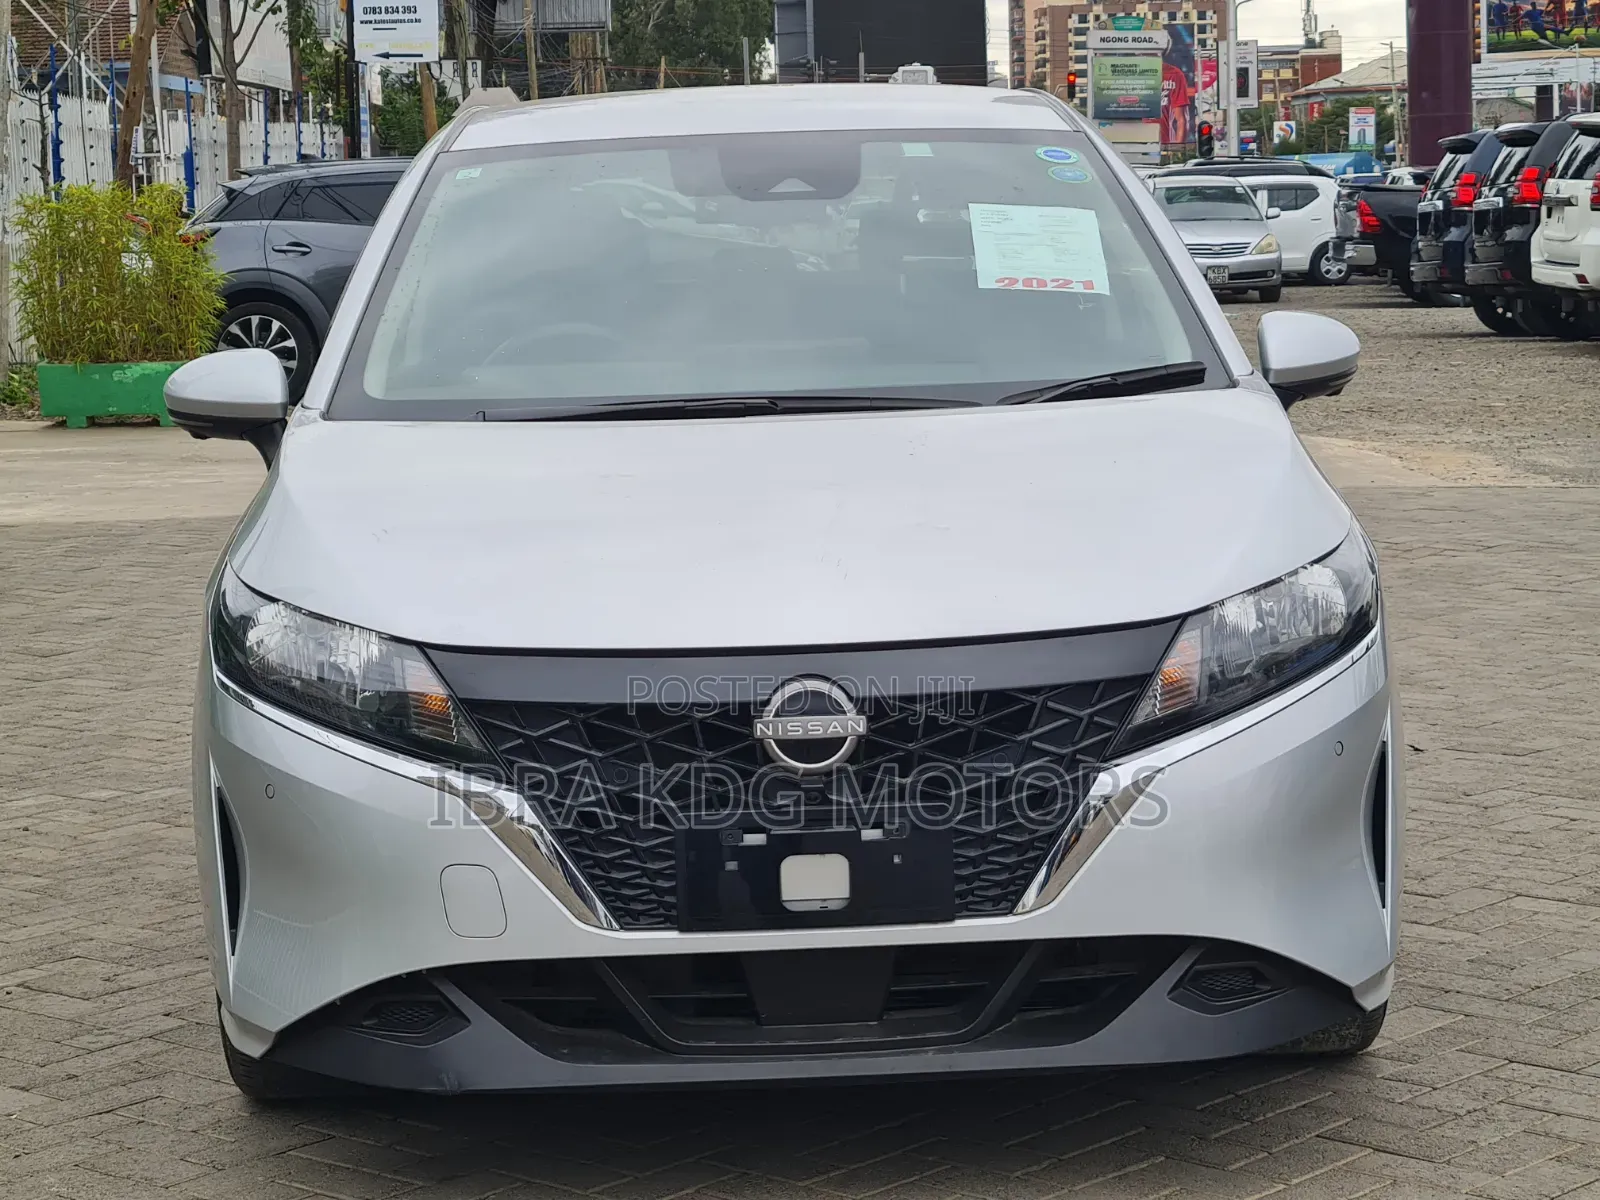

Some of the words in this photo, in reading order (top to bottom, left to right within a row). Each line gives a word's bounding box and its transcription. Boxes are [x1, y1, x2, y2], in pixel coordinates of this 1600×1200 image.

[363, 6, 382, 15] 0783
[384, 6, 400, 15] 834
[401, 5, 417, 14] 393
[1212, 267, 1227, 275] KBX
[994, 277, 1095, 291] 2021
[1208, 275, 1227, 283] 685D
[755, 719, 865, 737] NISSAN
